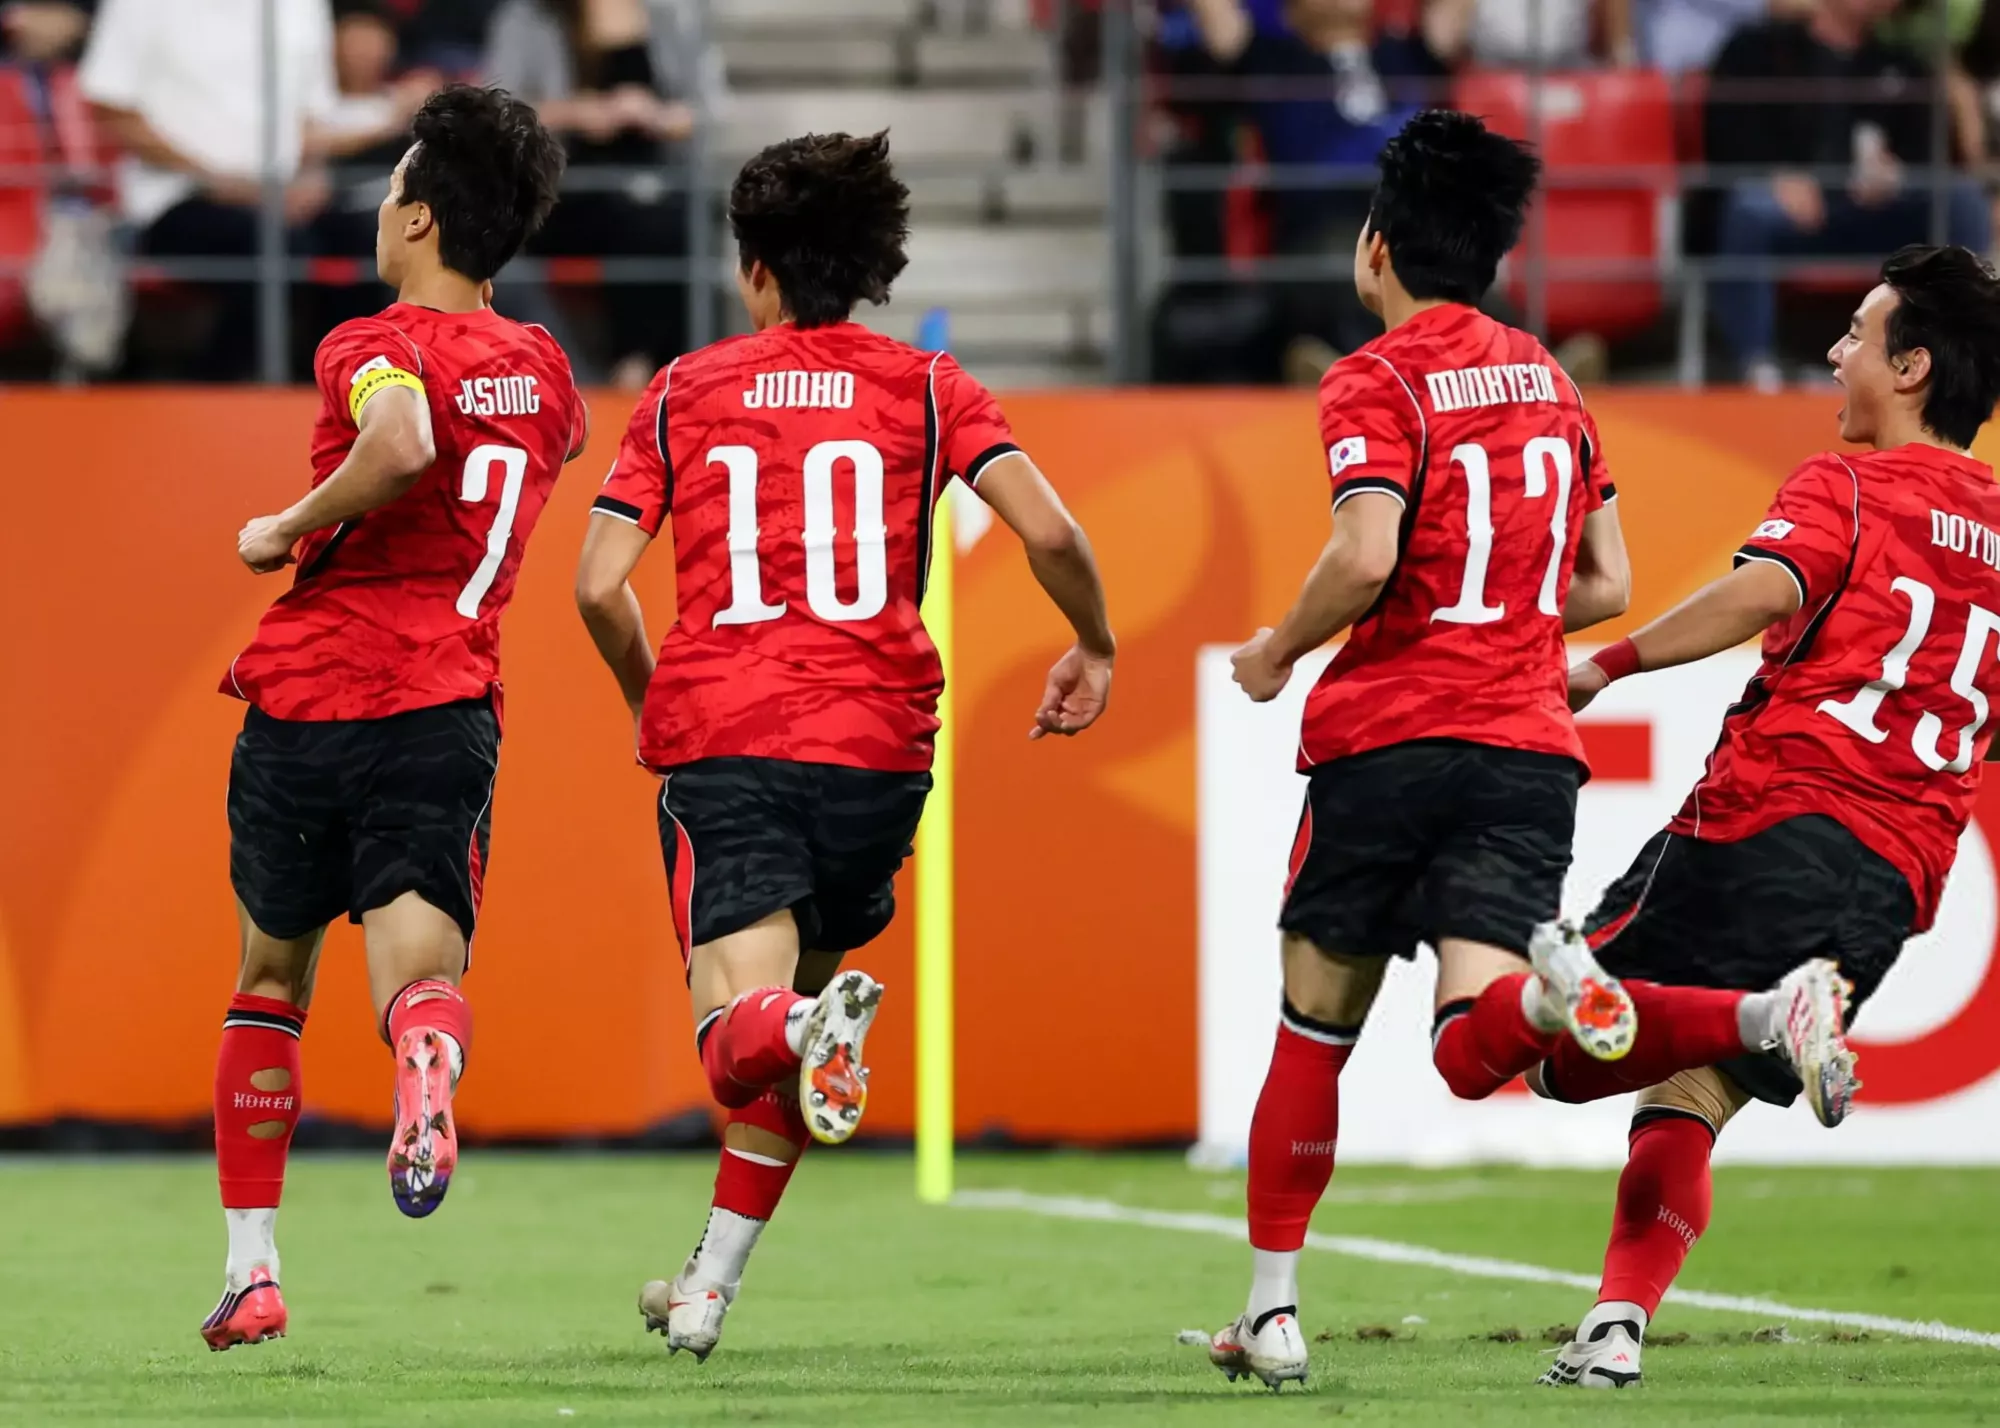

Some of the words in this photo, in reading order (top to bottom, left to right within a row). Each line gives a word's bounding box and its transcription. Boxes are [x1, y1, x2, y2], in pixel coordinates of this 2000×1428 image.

[352, 372, 405, 414] aptain
[455, 375, 540, 416] JISUNG
[742, 369, 855, 409] JUNHO
[456, 444, 528, 620] 7
[706, 439, 888, 632] 10
[1429, 436, 1573, 625] 17
[1815, 575, 2000, 774] 15
[233, 1091, 294, 1110] KOREA
[1289, 1139, 1337, 1156] KORE
